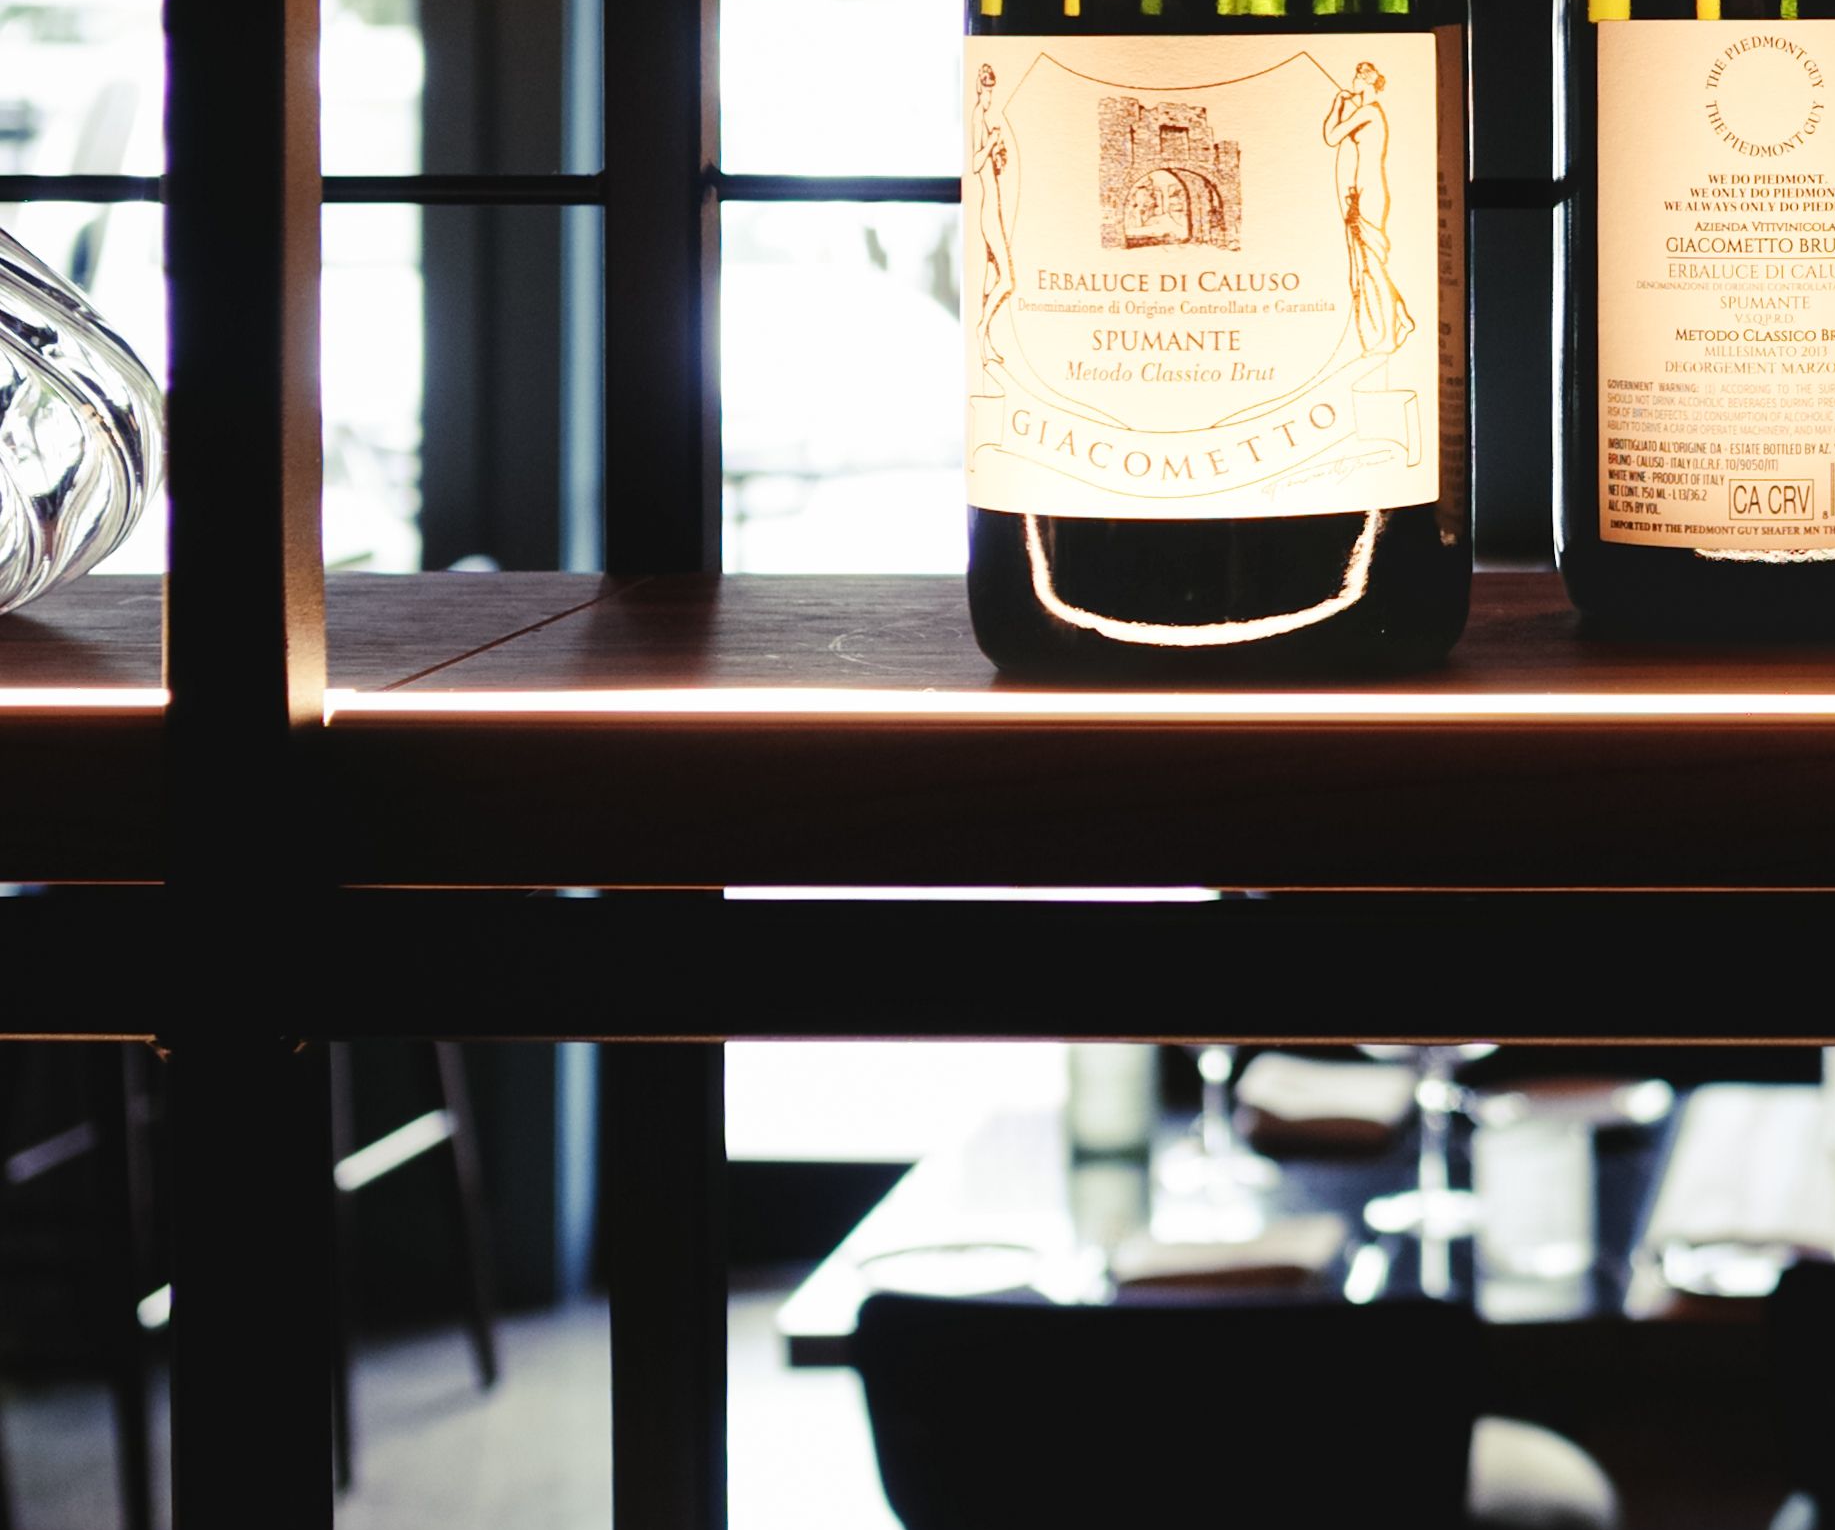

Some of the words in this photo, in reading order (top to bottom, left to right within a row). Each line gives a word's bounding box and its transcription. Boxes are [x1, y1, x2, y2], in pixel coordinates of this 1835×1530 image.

[1705, 58, 1727, 90] THE
[1724, 35, 1808, 61] PIEDMONT
[1804, 59, 1824, 89] GUY
[1705, 100, 1727, 135] THE
[1723, 131, 1804, 157] PIEDMONT
[1803, 100, 1824, 135] GUY
[1708, 174, 1727, 184] WE
[1731, 174, 1750, 184] DO
[1690, 188, 1710, 198] WE
[1712, 188, 1747, 198] ONLY
[1750, 188, 1770, 198] DO
[1664, 201, 1683, 212] WE
[1685, 202, 1737, 212] ALWAYS
[1740, 202, 1777, 212] ONLY
[1780, 202, 1799, 212] DO
[1695, 222, 1748, 232] AZIENDA
[1666, 237, 1793, 253] GIACOMETTO
[1668, 264, 1759, 279] ERBALUCE
[1766, 264, 1784, 279] DI
[1036, 268, 1150, 292] ERBALUCE
[1160, 273, 1188, 292] DI
[1198, 270, 1300, 292] CALUSO
[1018, 298, 1104, 314] Denominazione
[1109, 298, 1121, 314] di
[1125, 300, 1174, 318] Origine
[1180, 301, 1258, 314] Controllata
[1263, 304, 1270, 314] e
[1274, 299, 1336, 313] Garantita
[1720, 296, 1811, 310] SPUMANTE
[1092, 330, 1241, 352] SPUMANTE
[1675, 328, 1739, 342] METODO
[1743, 328, 1816, 342] CLASSICO
[1704, 346, 1797, 357] MILLESIMATO
[1066, 362, 1132, 382] Metodo
[1141, 363, 1221, 382] Classico
[1231, 365, 1275, 382] Brut
[1665, 361, 1777, 374] DEGORGEMENT
[1721, 384, 1771, 394] ACCORDING
[1777, 384, 1789, 394] TO
[1796, 383, 1812, 394] THE
[1636, 394, 1649, 405] NOT
[1652, 395, 1675, 406] DRINK
[1678, 396, 1724, 407] ALCOHOLIC
[1728, 398, 1776, 408] BEVERAGES
[1781, 398, 1814, 408] DURING
[1704, 411, 1767, 422] CONSUMPTION
[1784, 411, 1833, 422] ALCOHOLIC
[1700, 425, 1736, 435] OPERATE
[1815, 425, 1833, 434] MAY
[1011, 403, 1337, 481] GIACOMETTO
[1729, 442, 1761, 455] ESTATE
[1763, 443, 1801, 455] BOTTLED
[1805, 443, 1815, 455] BY
[1607, 452, 1631, 466] BRUNO
[1636, 455, 1664, 468] CALUSO
[1670, 457, 1691, 469] ITALY
[1607, 469, 1626, 481] WHITE
[1629, 470, 1646, 482] WINE
[1652, 471, 1688, 484] PRODUCT
[1691, 473, 1700, 485] OF
[1703, 473, 1725, 486] ITALY
[1733, 485, 1761, 515] CA
[1768, 485, 1810, 514] CRV
[1610, 519, 1650, 531] IMPORTED
[1652, 523, 1662, 532] BY
[1664, 523, 1682, 534] THE
[1684, 524, 1735, 535] PIEDMONT
[1737, 526, 1758, 535] GUY
[1803, 526, 1819, 536] MN
